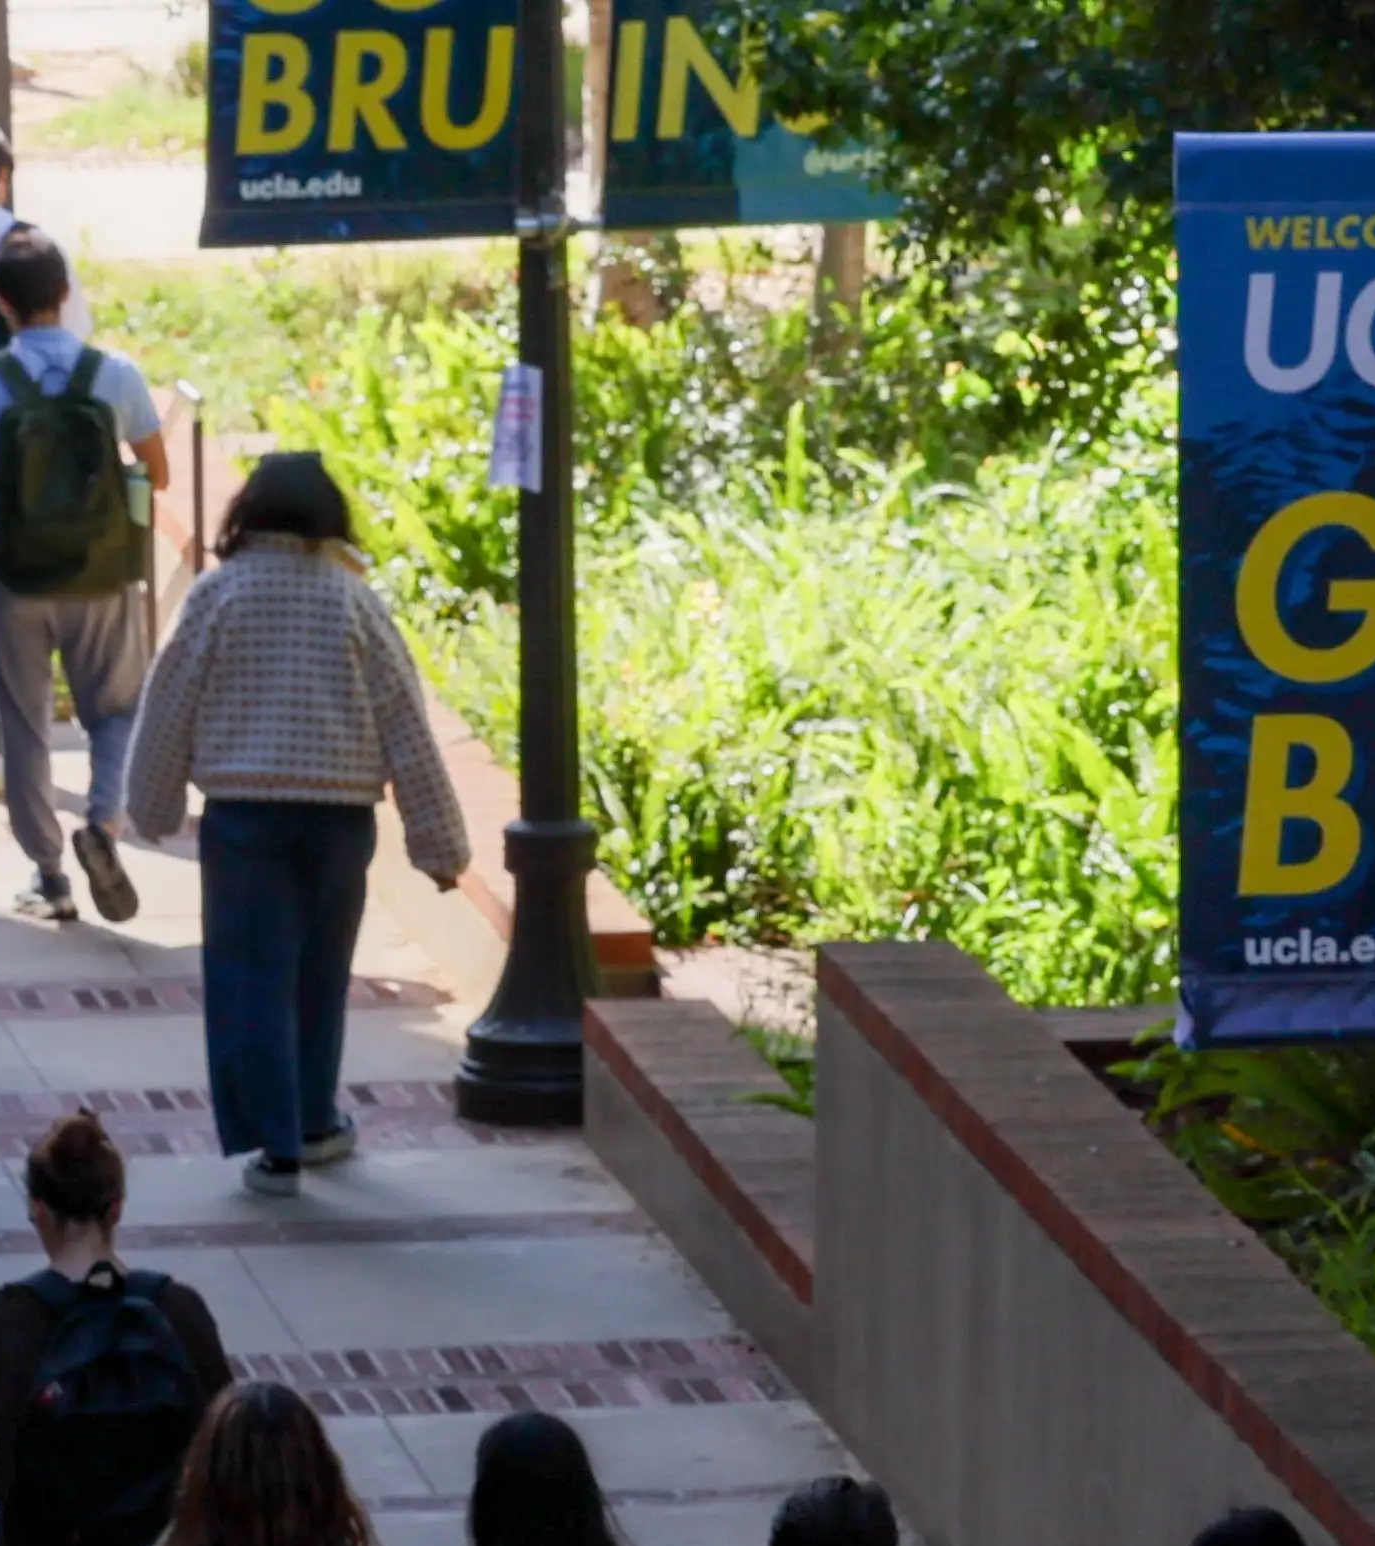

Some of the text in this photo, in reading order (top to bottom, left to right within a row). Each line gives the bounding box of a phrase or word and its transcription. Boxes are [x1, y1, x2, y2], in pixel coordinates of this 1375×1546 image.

[234, 25, 515, 155] BRU
[611, 15, 766, 141] IN
[239, 169, 362, 200] ucla.edu
